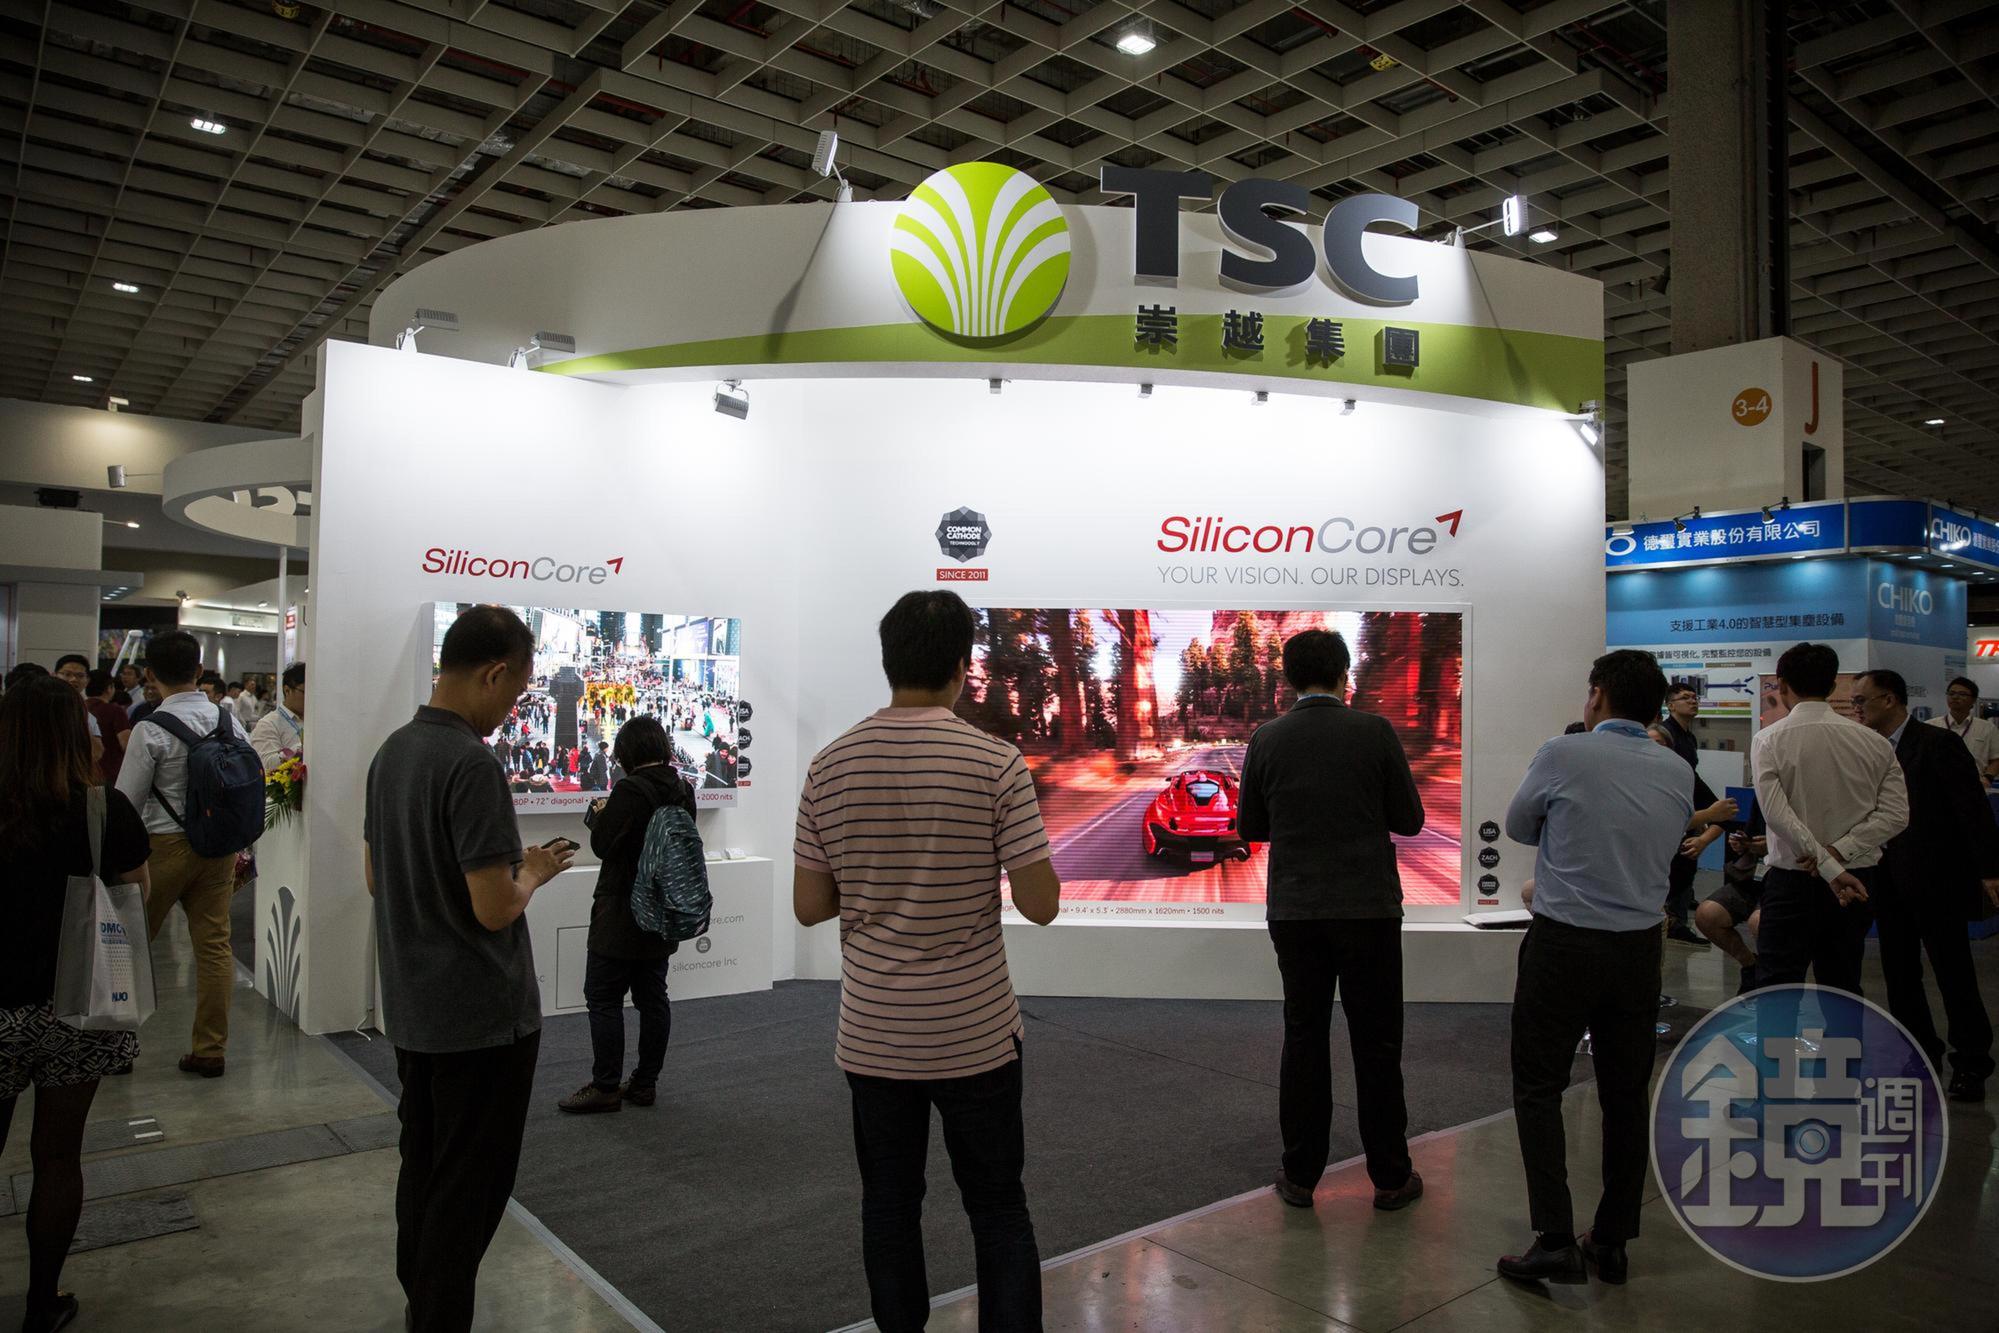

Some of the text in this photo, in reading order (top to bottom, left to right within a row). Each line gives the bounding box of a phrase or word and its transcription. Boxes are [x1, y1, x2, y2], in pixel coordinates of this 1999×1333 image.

[1101, 166, 1419, 306] TSC
[1134, 304, 1420, 369] 崇越集團
[1735, 395, 1769, 417] 3-4
[1804, 361, 1819, 435] J
[1156, 515, 1437, 555] SiliconCore
[1932, 518, 1971, 547] CHIKO
[422, 547, 608, 585] SiliconCore
[939, 570, 986, 580] SINCE 2011
[1156, 566, 1465, 588] YOUR VISION. OUR DISPLAYS.
[1878, 582, 1933, 616] CHIKO
[551, 796, 584, 807] diagonal
[701, 793, 734, 801] 2000 nits
[1193, 907, 1210, 915] 1500
[1211, 907, 1225, 915] nits
[672, 960, 721, 972] siliconcore
